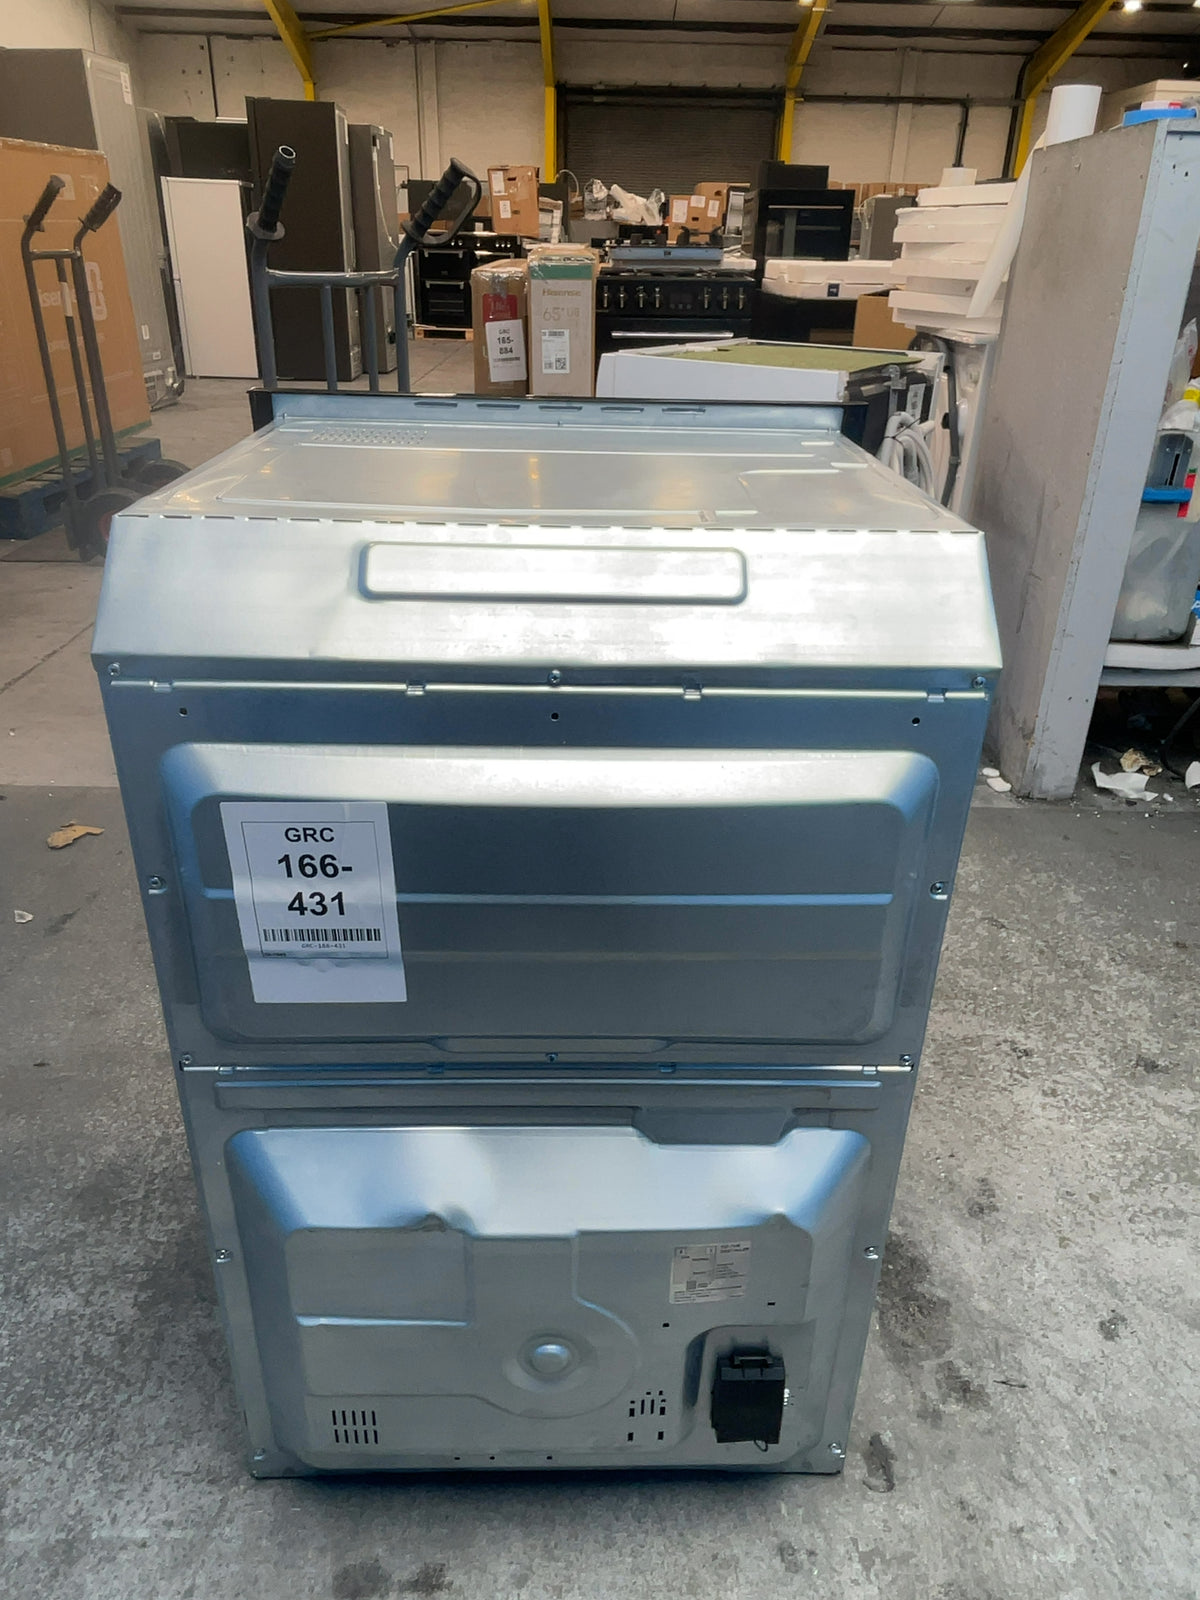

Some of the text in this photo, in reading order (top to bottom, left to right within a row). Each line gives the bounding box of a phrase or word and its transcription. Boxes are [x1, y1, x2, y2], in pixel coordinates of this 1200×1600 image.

[284, 826, 335, 843] GRC
[277, 853, 353, 879] 166-
[287, 891, 346, 916] 431
